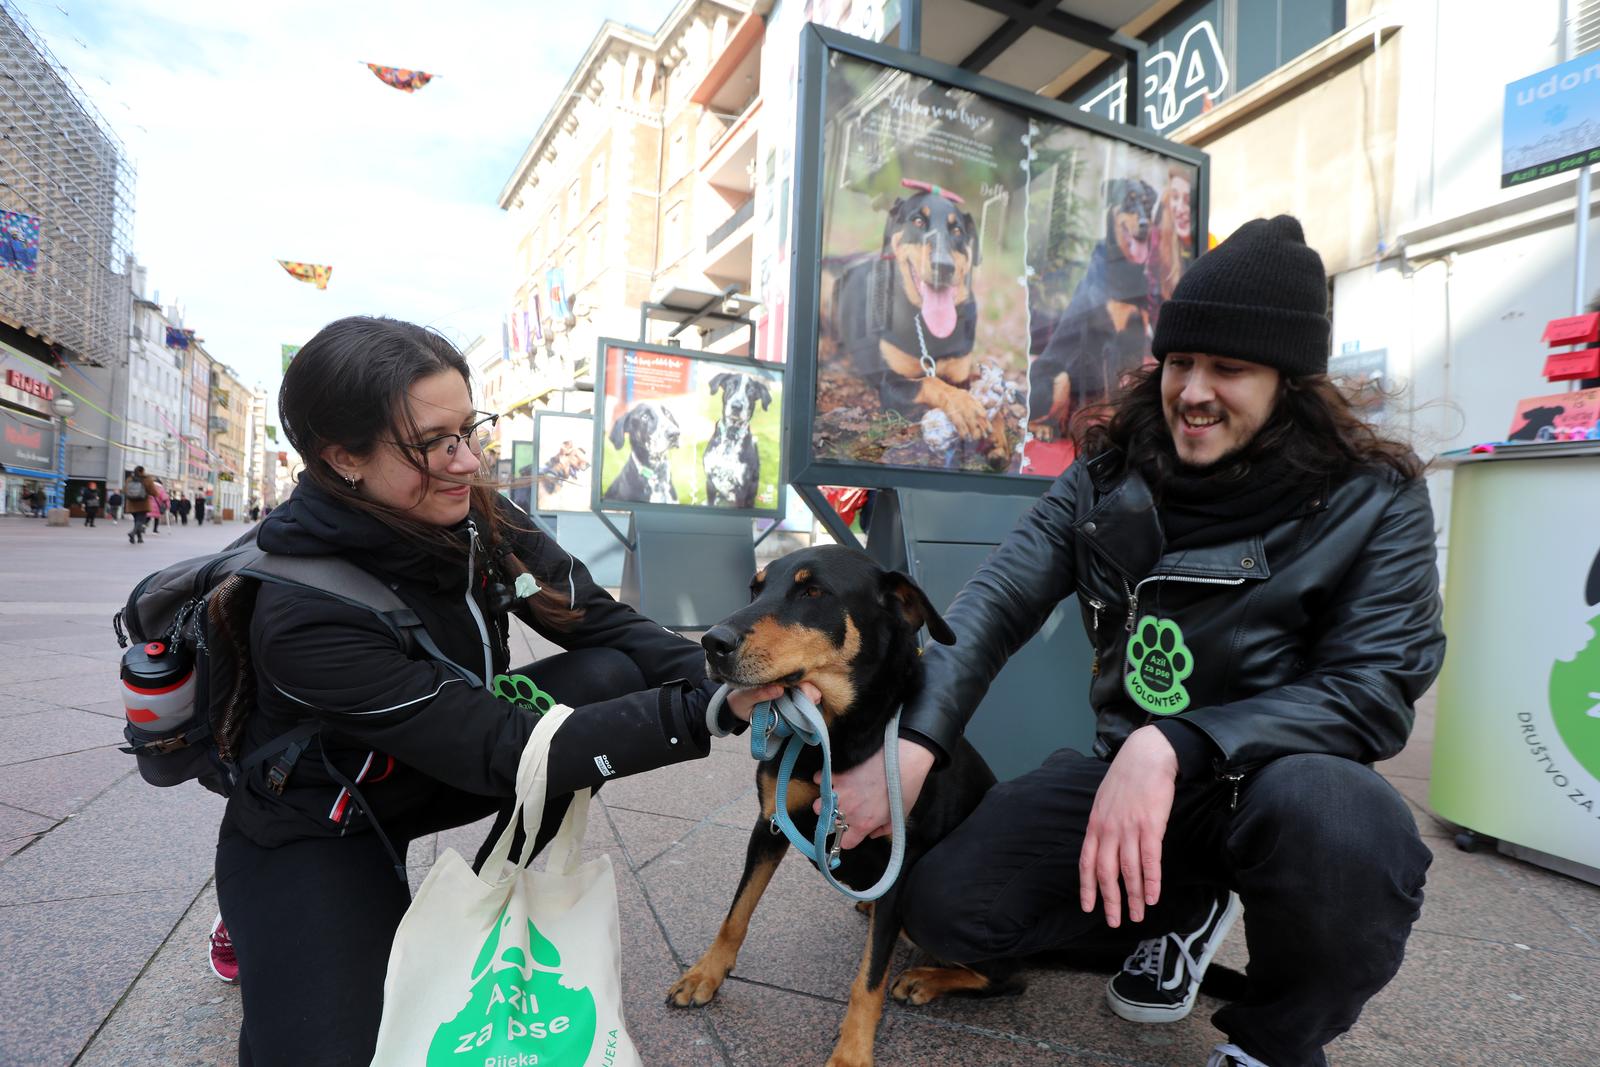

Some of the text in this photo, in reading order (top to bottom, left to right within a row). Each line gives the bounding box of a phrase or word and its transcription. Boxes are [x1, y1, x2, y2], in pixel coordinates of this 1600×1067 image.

[1144, 665, 1170, 679] za pse
[1150, 656, 1166, 667] Azil
[1132, 677, 1183, 707] VOLONTER
[1517, 712, 1594, 813] DRUŠTVO ZA
[486, 983, 540, 1016] Azil
[454, 1016, 570, 1053] za pse
